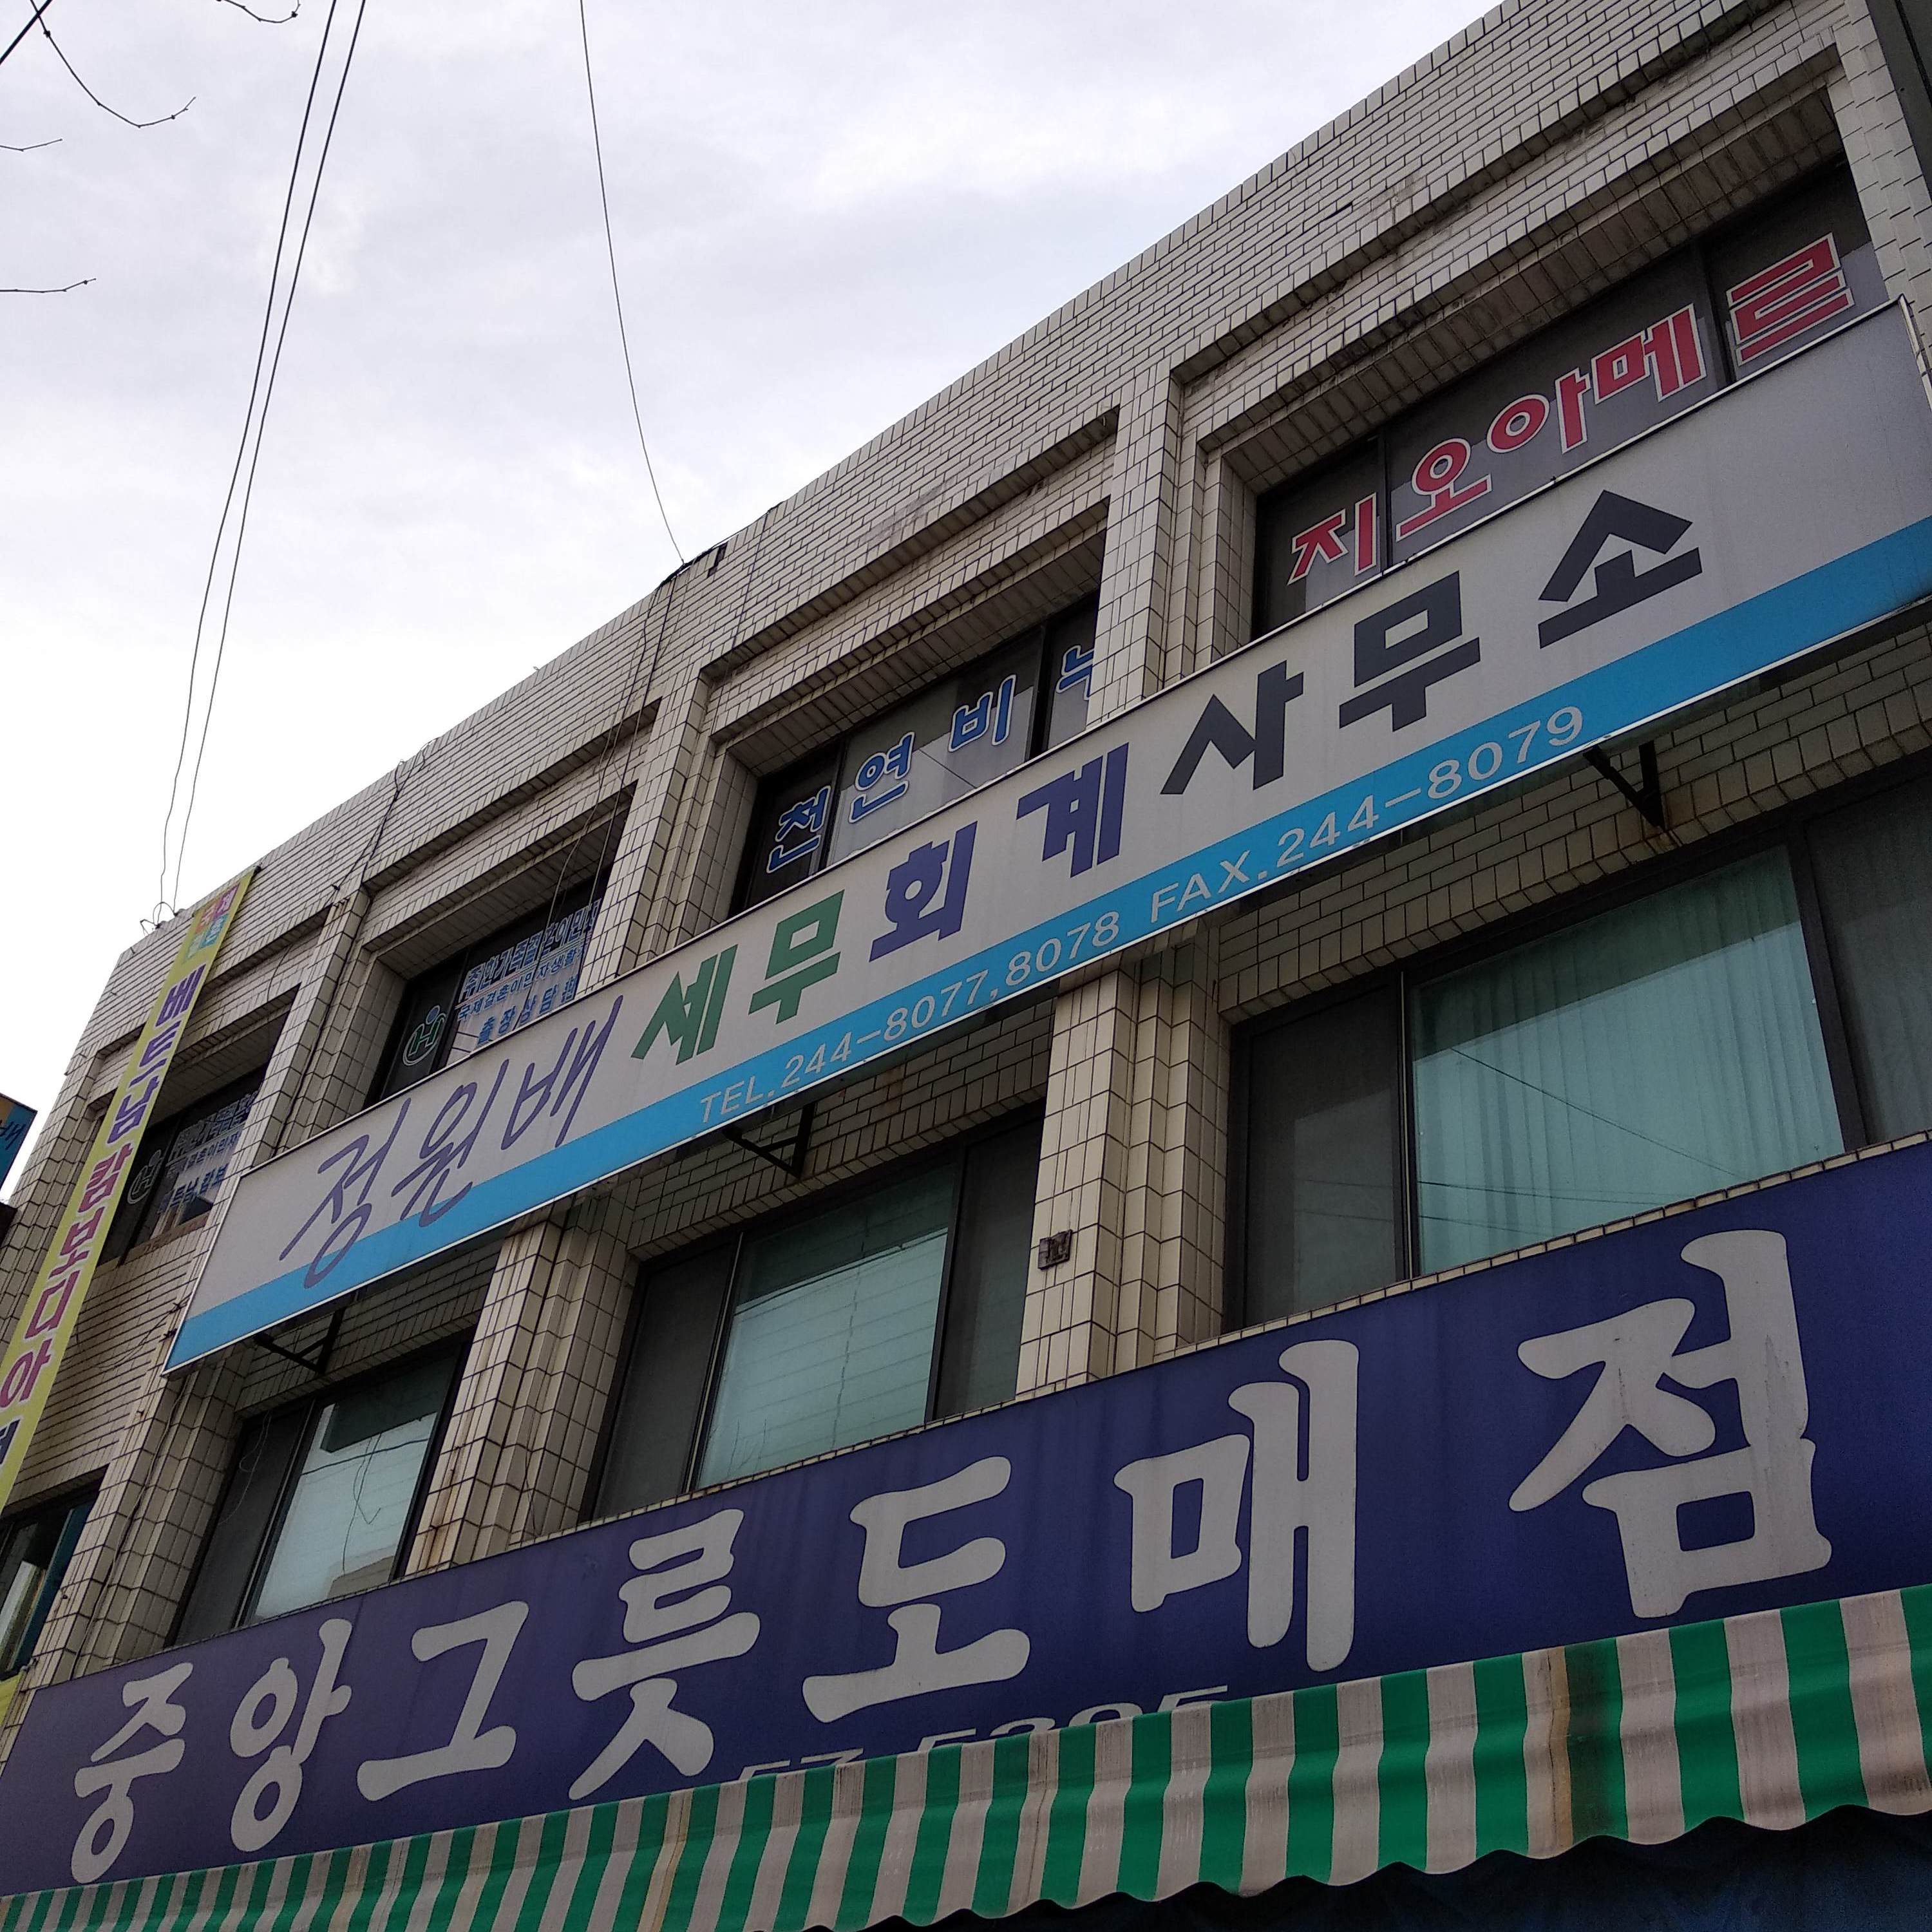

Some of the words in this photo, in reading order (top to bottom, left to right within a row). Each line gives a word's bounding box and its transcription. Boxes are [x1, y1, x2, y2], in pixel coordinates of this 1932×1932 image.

[1287, 232, 1855, 586] 지오아메르
[108, 963, 207, 1148] 베트남
[279, 994, 623, 1289] 정원배
